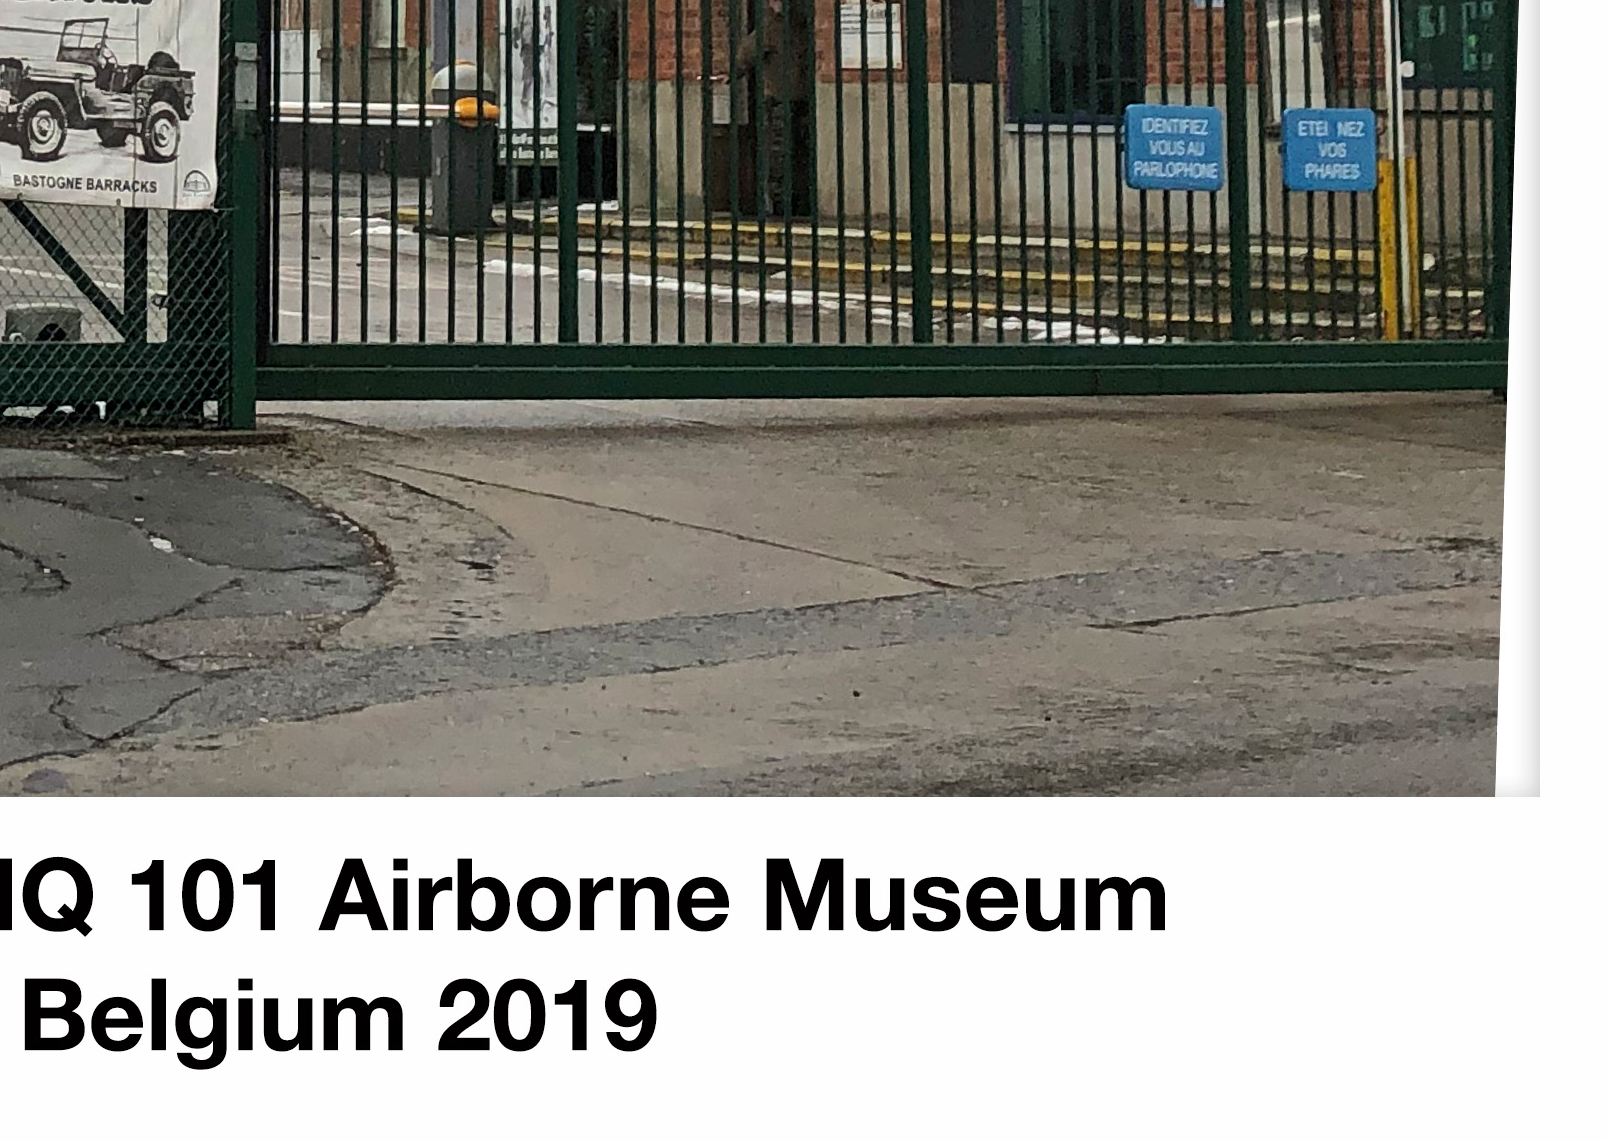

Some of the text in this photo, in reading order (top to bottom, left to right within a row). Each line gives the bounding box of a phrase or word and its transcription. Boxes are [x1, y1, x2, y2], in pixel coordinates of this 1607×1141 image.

[1142, 117, 1209, 135] IDENTIFIEZ
[1297, 120, 1365, 138] ETEINEZ
[1149, 140, 1205, 156] VOUS AU
[1318, 142, 1347, 158] VOS
[1133, 161, 1219, 179] PARLOPHONE
[1304, 163, 1361, 180] PHARES
[13, 174, 158, 194] BASTOGNE BARRACKS
